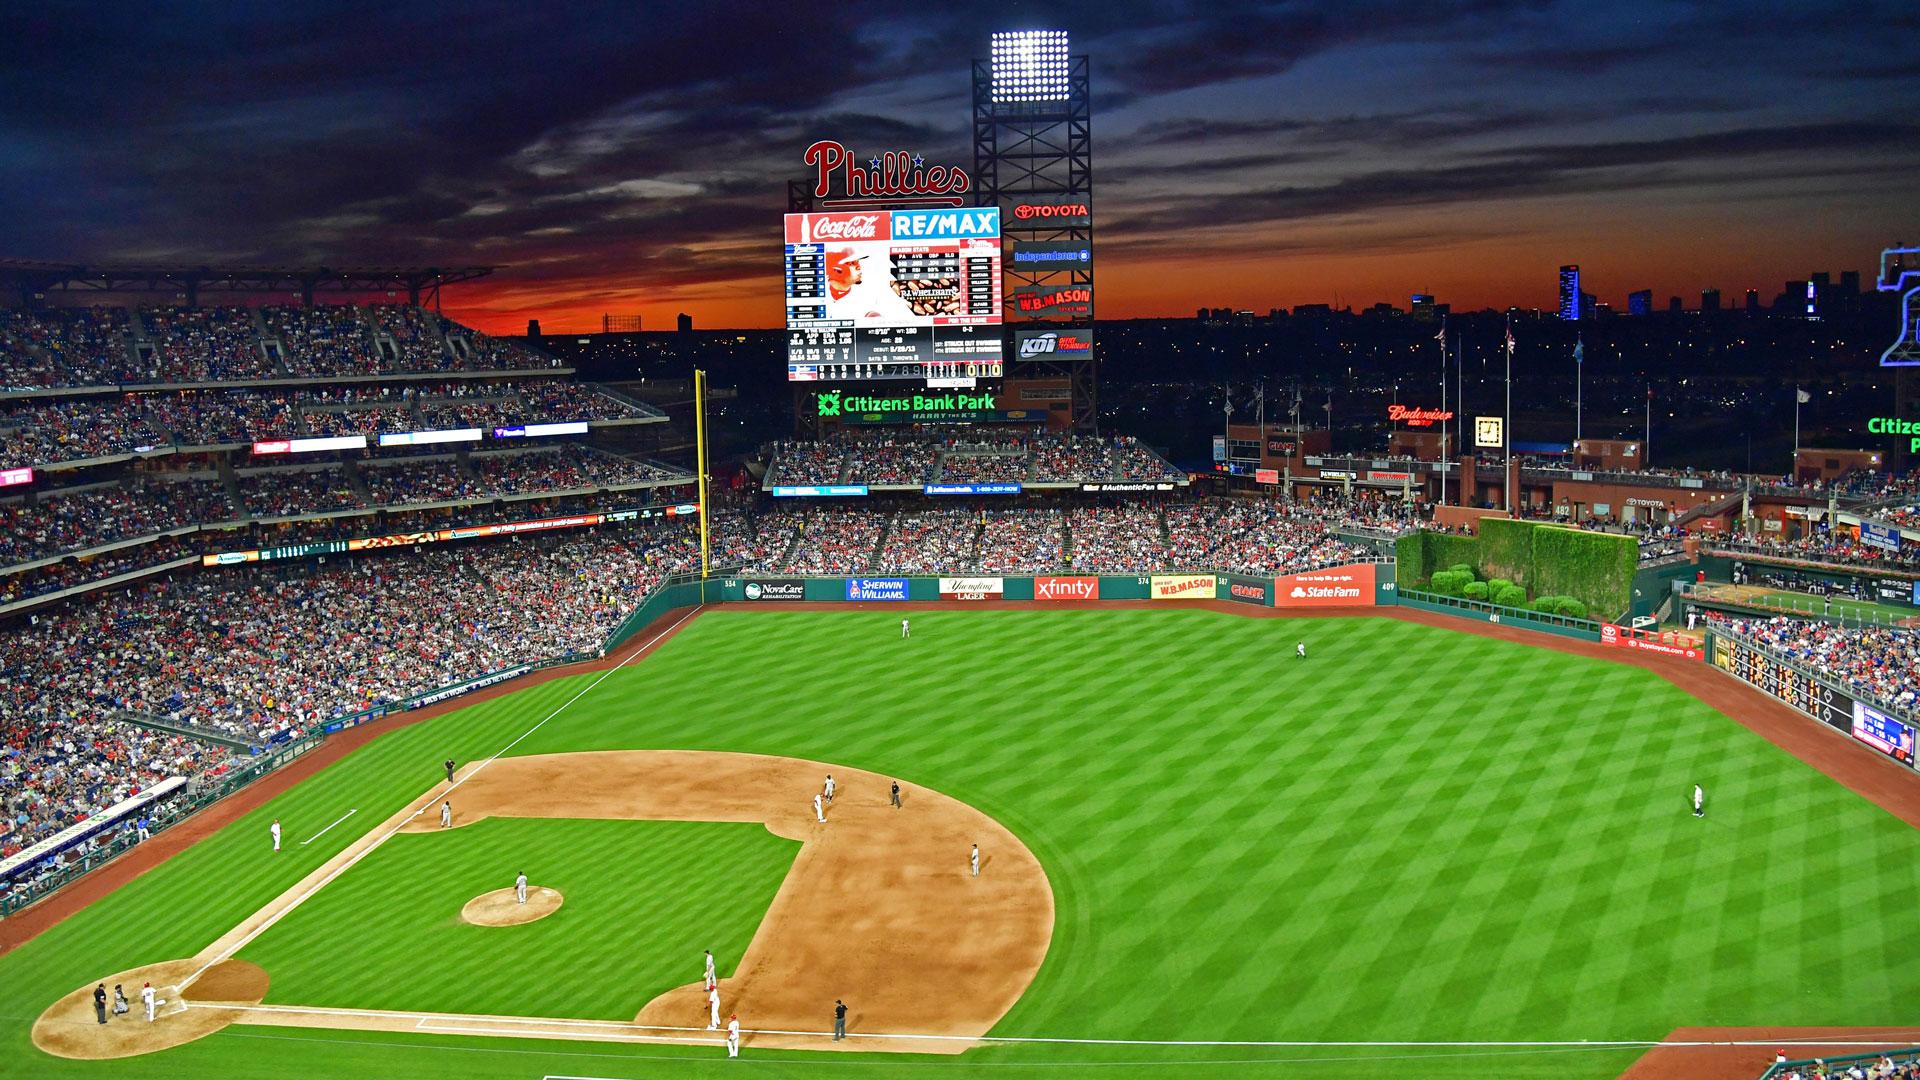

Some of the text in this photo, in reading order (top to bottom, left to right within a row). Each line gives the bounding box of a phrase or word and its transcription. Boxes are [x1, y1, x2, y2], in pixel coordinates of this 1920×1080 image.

[804, 140, 969, 197] Phillies
[1033, 205, 1088, 217] TOYOTA
[895, 213, 994, 236] RE/MAX
[968, 365, 975, 376] 0
[991, 365, 1000, 376] 0
[843, 393, 995, 411] Citizens Bank Park
[1388, 405, 1453, 420] Budweiser
[1637, 499, 1664, 507] TOYOTA
[1555, 505, 1569, 516] 482
[762, 584, 803, 593] NovaCare
[862, 580, 903, 589] SHERWIN
[949, 579, 993, 592] Yuengling
[1038, 579, 1094, 598] xfinity
[1382, 583, 1394, 591] 409
[1231, 585, 1264, 599] GIANT
[1307, 586, 1360, 597] State Farm
[1489, 614, 1500, 623] 401
[491, 671, 520, 684] NETWORK
[438, 687, 468, 701] NETWORK
